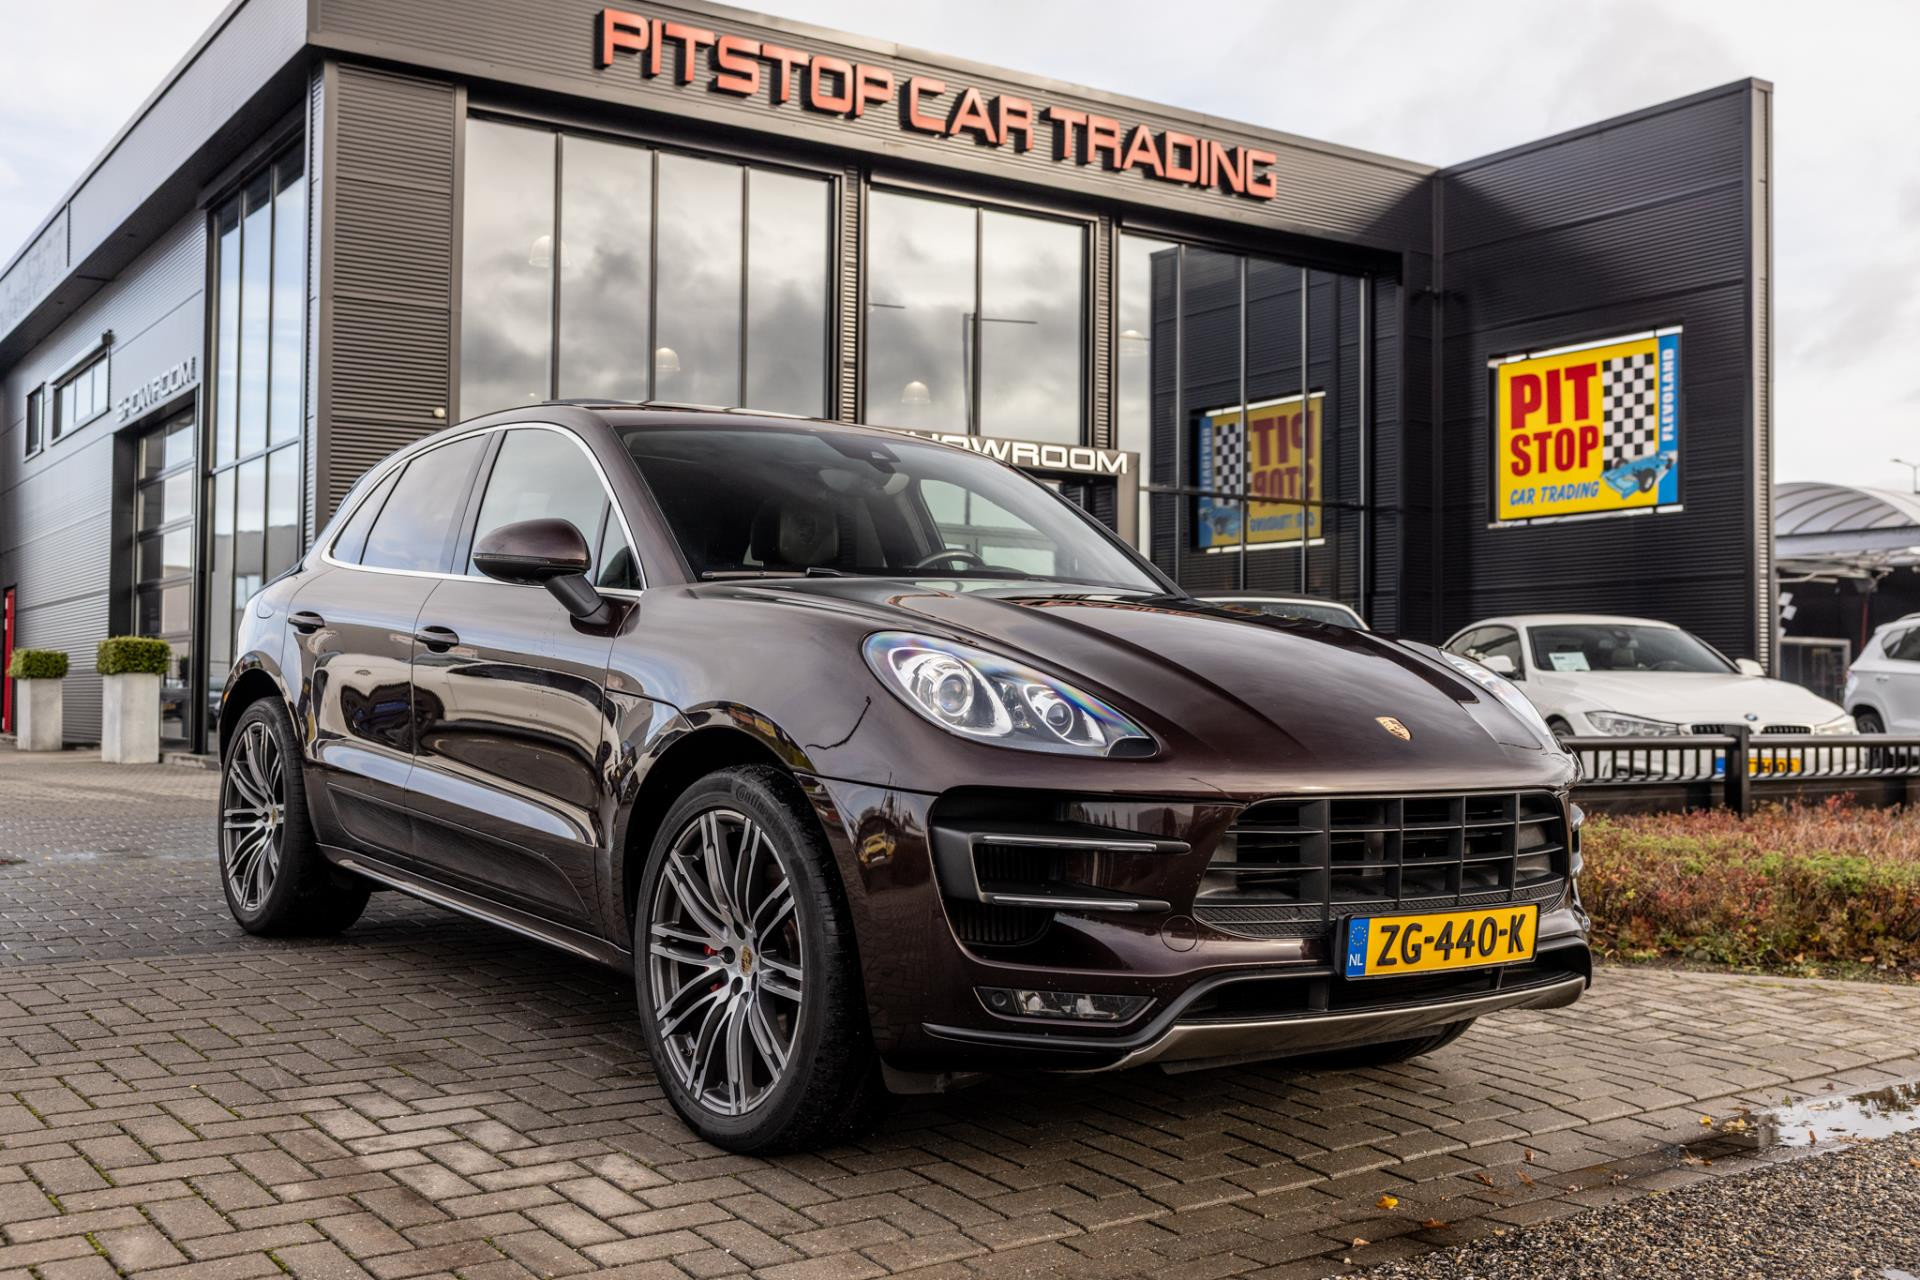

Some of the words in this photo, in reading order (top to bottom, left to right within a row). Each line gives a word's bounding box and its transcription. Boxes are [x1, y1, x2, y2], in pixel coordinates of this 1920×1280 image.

[597, 8, 895, 119] PITSTOP
[904, 76, 1034, 153] CAR
[1045, 106, 1278, 200] TRADING
[1511, 363, 1598, 430] PIT
[1662, 348, 1675, 443] FLEVOLAND
[905, 431, 1128, 475] OWROOM
[1511, 425, 1599, 477] STOP
[1510, 487, 1536, 506] CAR
[1540, 480, 1599, 504] TRADING
[1349, 953, 1363, 966] NL
[1376, 913, 1527, 967] ZG-440-K
